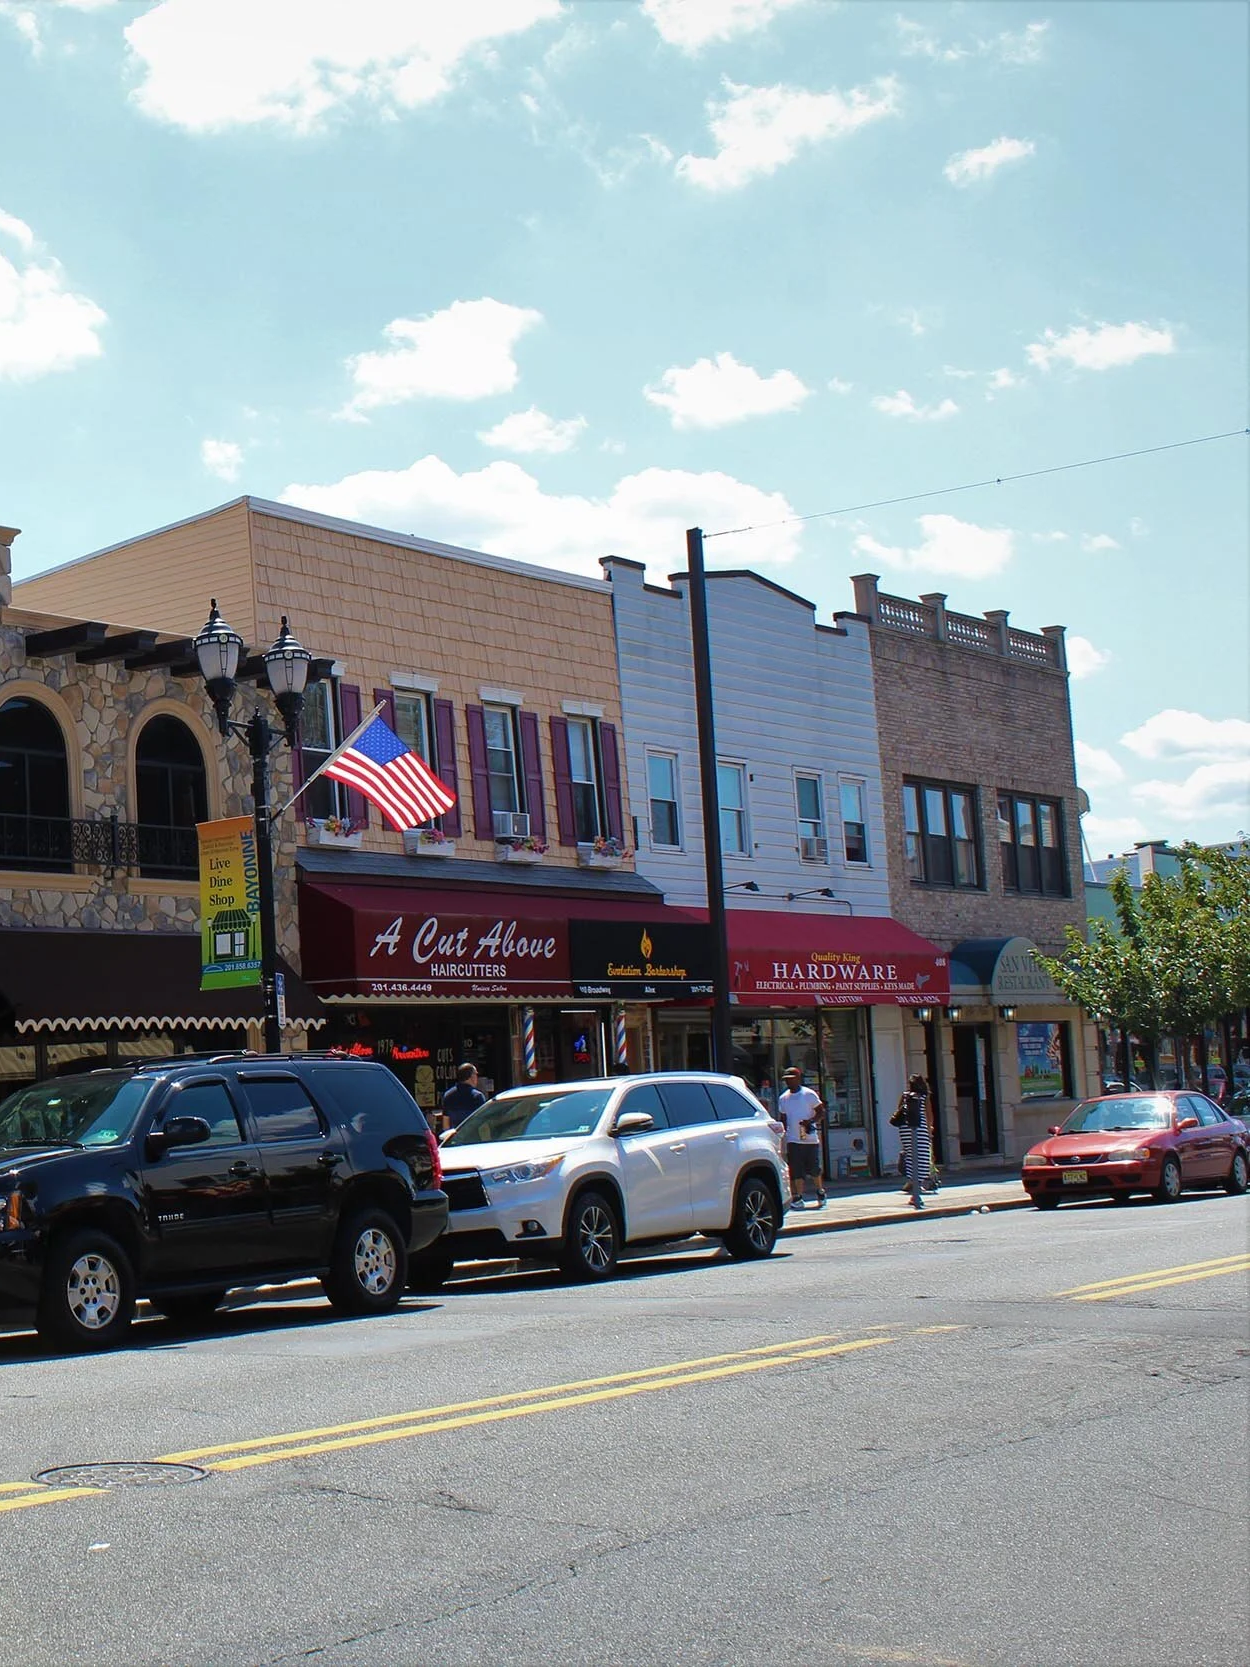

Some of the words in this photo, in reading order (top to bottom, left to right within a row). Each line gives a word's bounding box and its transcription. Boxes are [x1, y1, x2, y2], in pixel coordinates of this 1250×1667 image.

[209, 858, 231, 870] Live
[240, 829, 261, 913] BAYONNE
[209, 876, 233, 888] Dine
[209, 894, 235, 907] Shop
[369, 916, 403, 957] A
[412, 916, 470, 964] Cut
[473, 920, 557, 959] Above
[811, 952, 841, 964] Quality
[842, 953, 861, 965] King
[431, 964, 507, 977] HAIRCUTTERS
[607, 963, 642, 977] Evolution
[644, 964, 687, 980] Barbershop
[772, 963, 898, 980] HARDWARE
[371, 983, 432, 992] 201.436.4449
[756, 981, 795, 990] ELECTRICAL
[799, 981, 831, 990] PLUMBING
[835, 982, 853, 990] PAINT
[853, 982, 880, 991] SUPPLIES
[883, 982, 898, 991] KEYS
[898, 982, 915, 991] MADE
